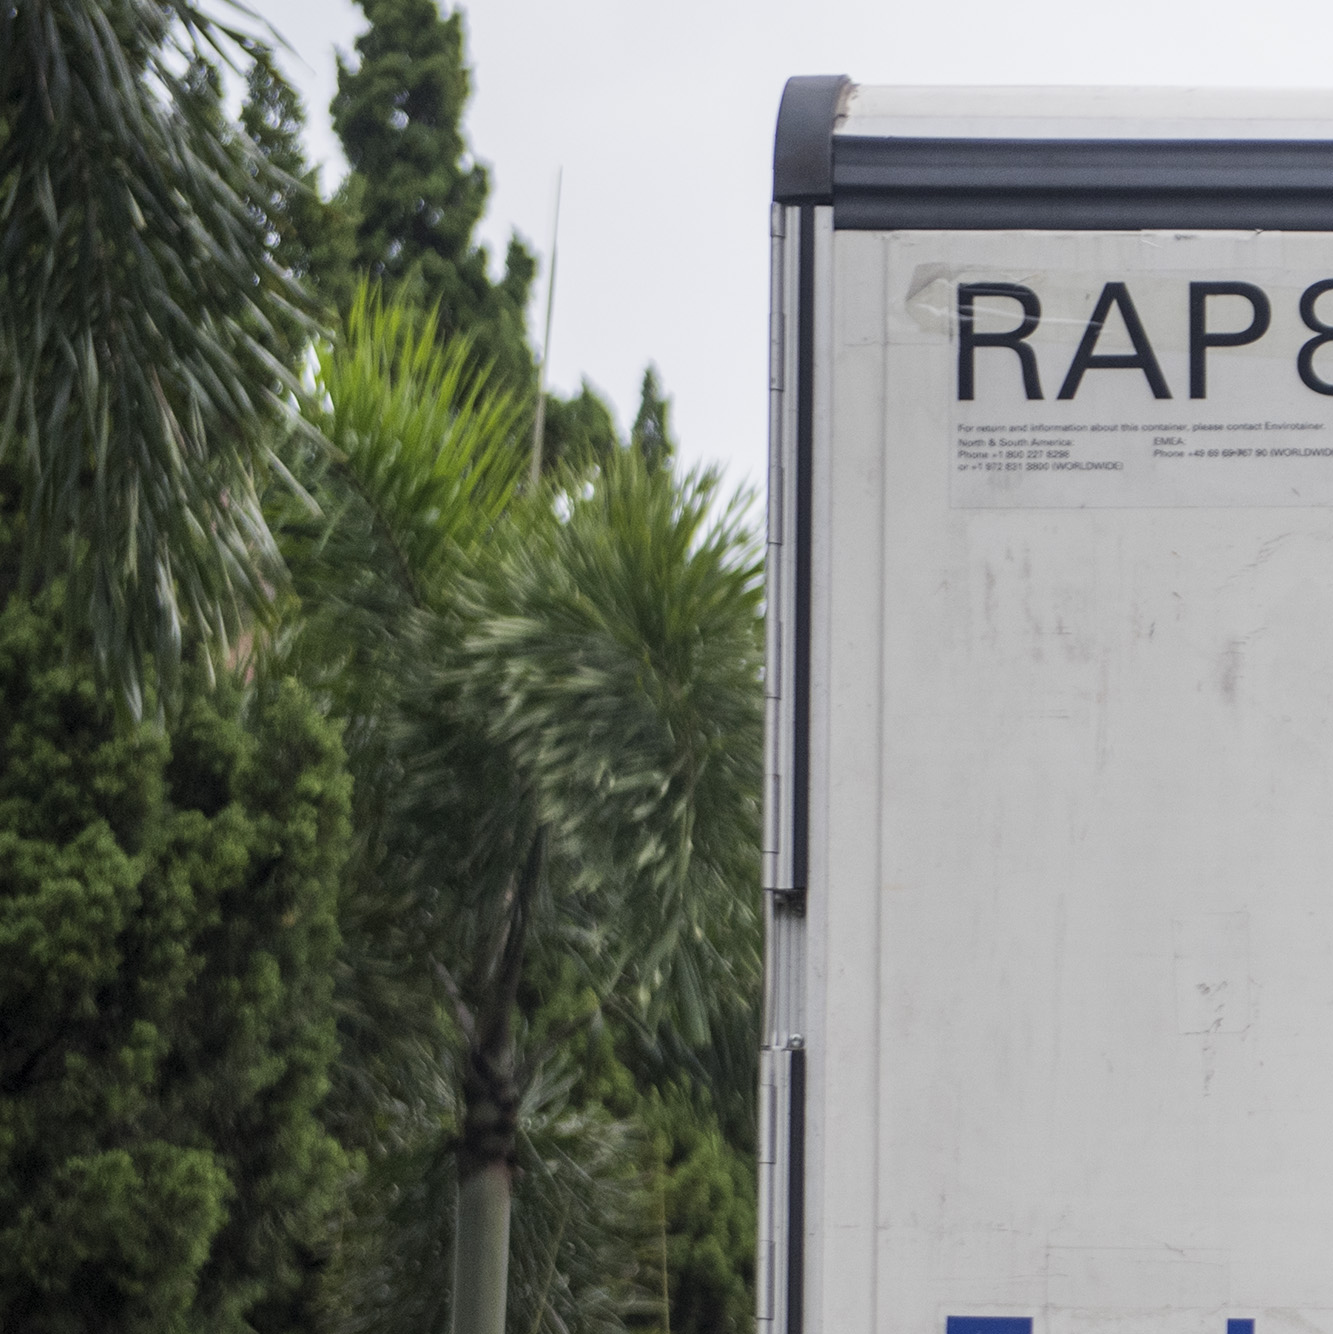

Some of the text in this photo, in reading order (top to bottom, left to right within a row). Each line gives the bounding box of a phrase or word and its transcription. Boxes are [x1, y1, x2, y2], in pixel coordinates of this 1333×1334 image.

[957, 424, 974, 432] For
[1009, 424, 1027, 432] and
[1030, 423, 1087, 432] information
[1090, 423, 1118, 432] about
[1121, 422, 1138, 431] this
[1192, 422, 1224, 431] please
[1227, 422, 1262, 430] contact
[957, 438, 986, 447] North
[999, 438, 1029, 447] South
[957, 450, 988, 459] Phone
[1153, 448, 1184, 458] Phone
